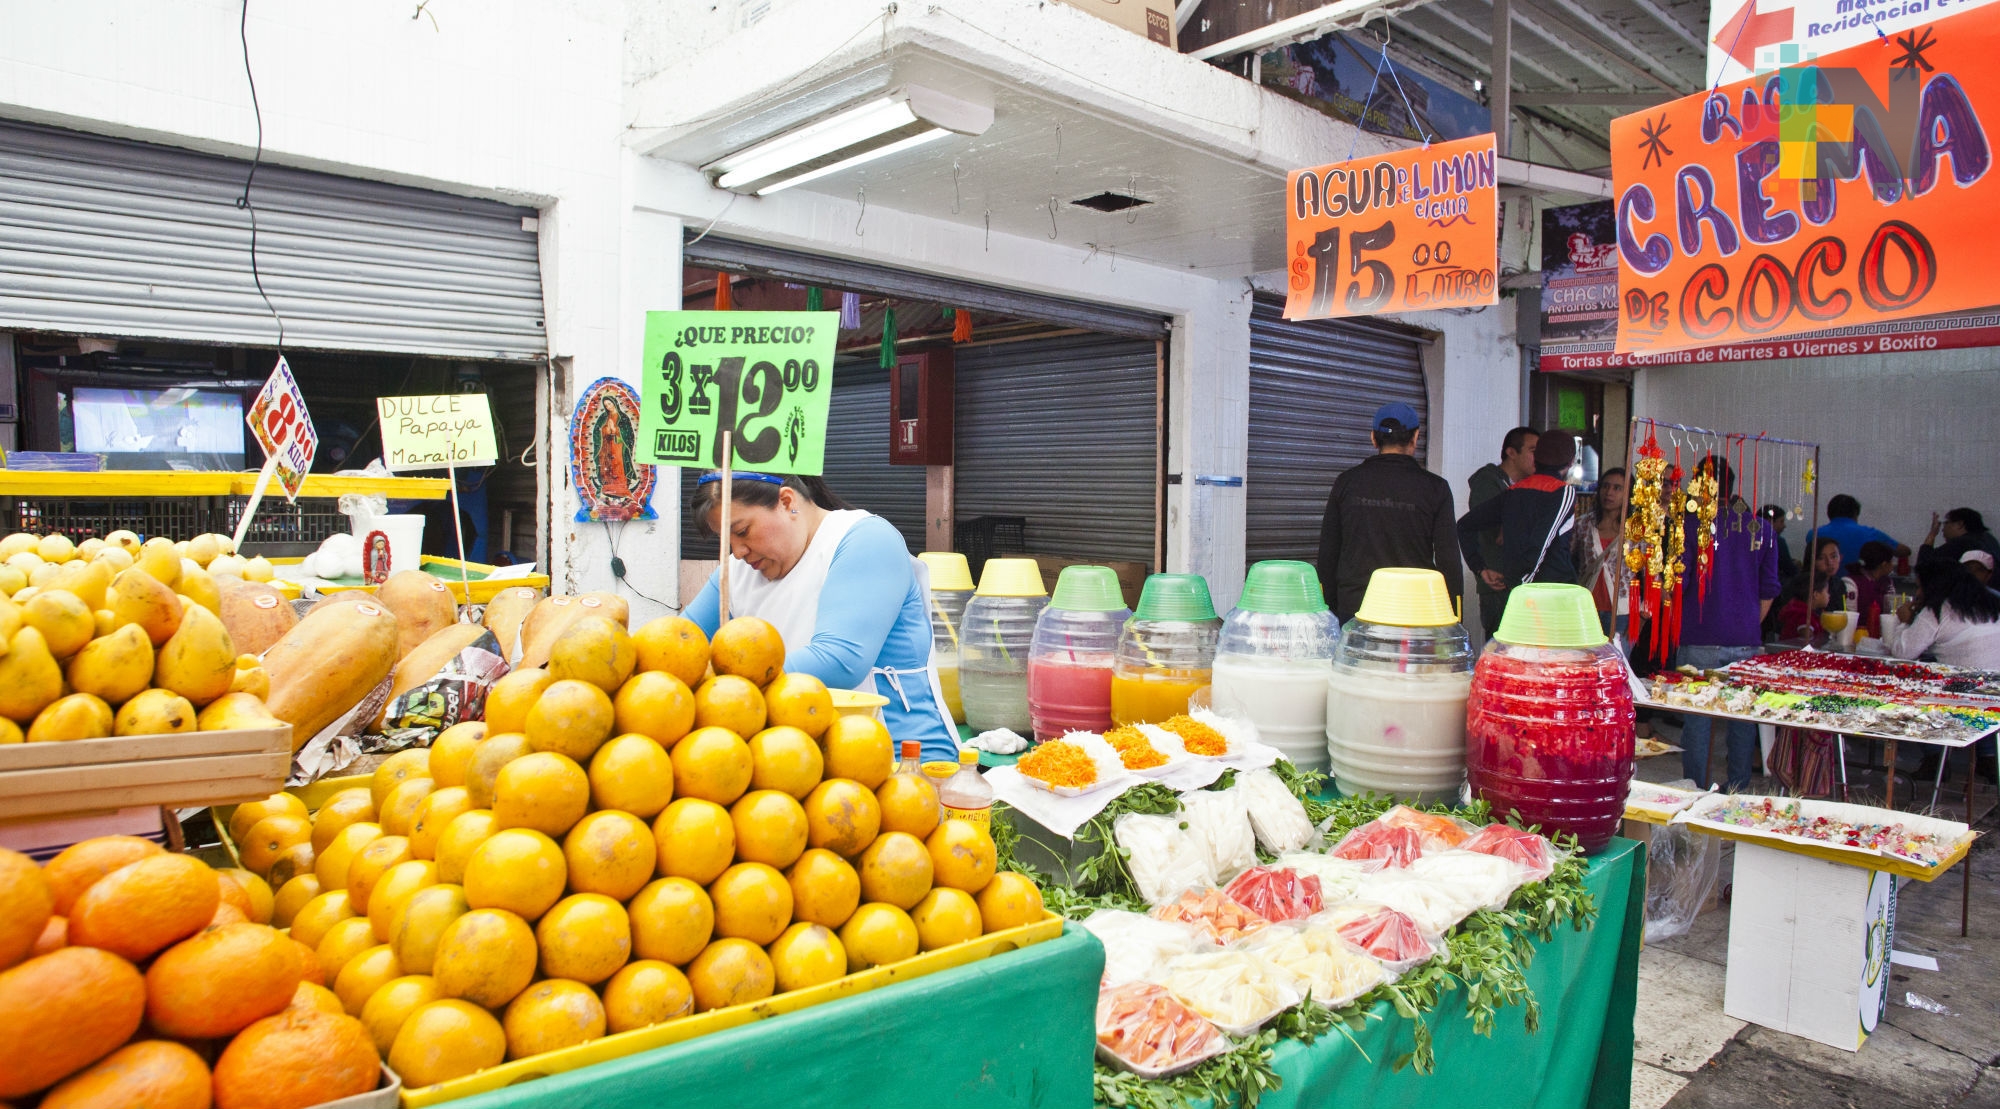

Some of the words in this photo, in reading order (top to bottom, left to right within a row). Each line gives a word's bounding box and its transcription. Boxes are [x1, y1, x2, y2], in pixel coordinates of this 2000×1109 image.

[1808, 0, 1930, 38] Residencial
[1296, 162, 1396, 219] AGUA
[1412, 149, 1495, 201] LIMON
[1617, 73, 1992, 278] CREMA
[1404, 267, 1495, 308] LITRO
[1553, 286, 1598, 304] CHAC
[1625, 288, 1669, 331] DE
[1678, 220, 1937, 339] COCO
[1547, 302, 1598, 315] ANTOJITOS
[674, 326, 726, 347] ¿QUE
[730, 326, 815, 344] PRECIO?
[1562, 354, 1603, 368] Tortas
[1607, 352, 1623, 366] de
[1627, 350, 1694, 366] Cochinita
[1697, 348, 1713, 362] de
[1718, 347, 1774, 361] Martes
[1779, 348, 1788, 357] a
[1793, 341, 1857, 356] Viernes
[1864, 341, 1874, 354] y
[1879, 335, 1938, 351] Boxito
[660, 351, 684, 425] 3
[382, 395, 461, 418] DULCE
[400, 417, 482, 438] Papaya
[657, 434, 696, 453] KILOS
